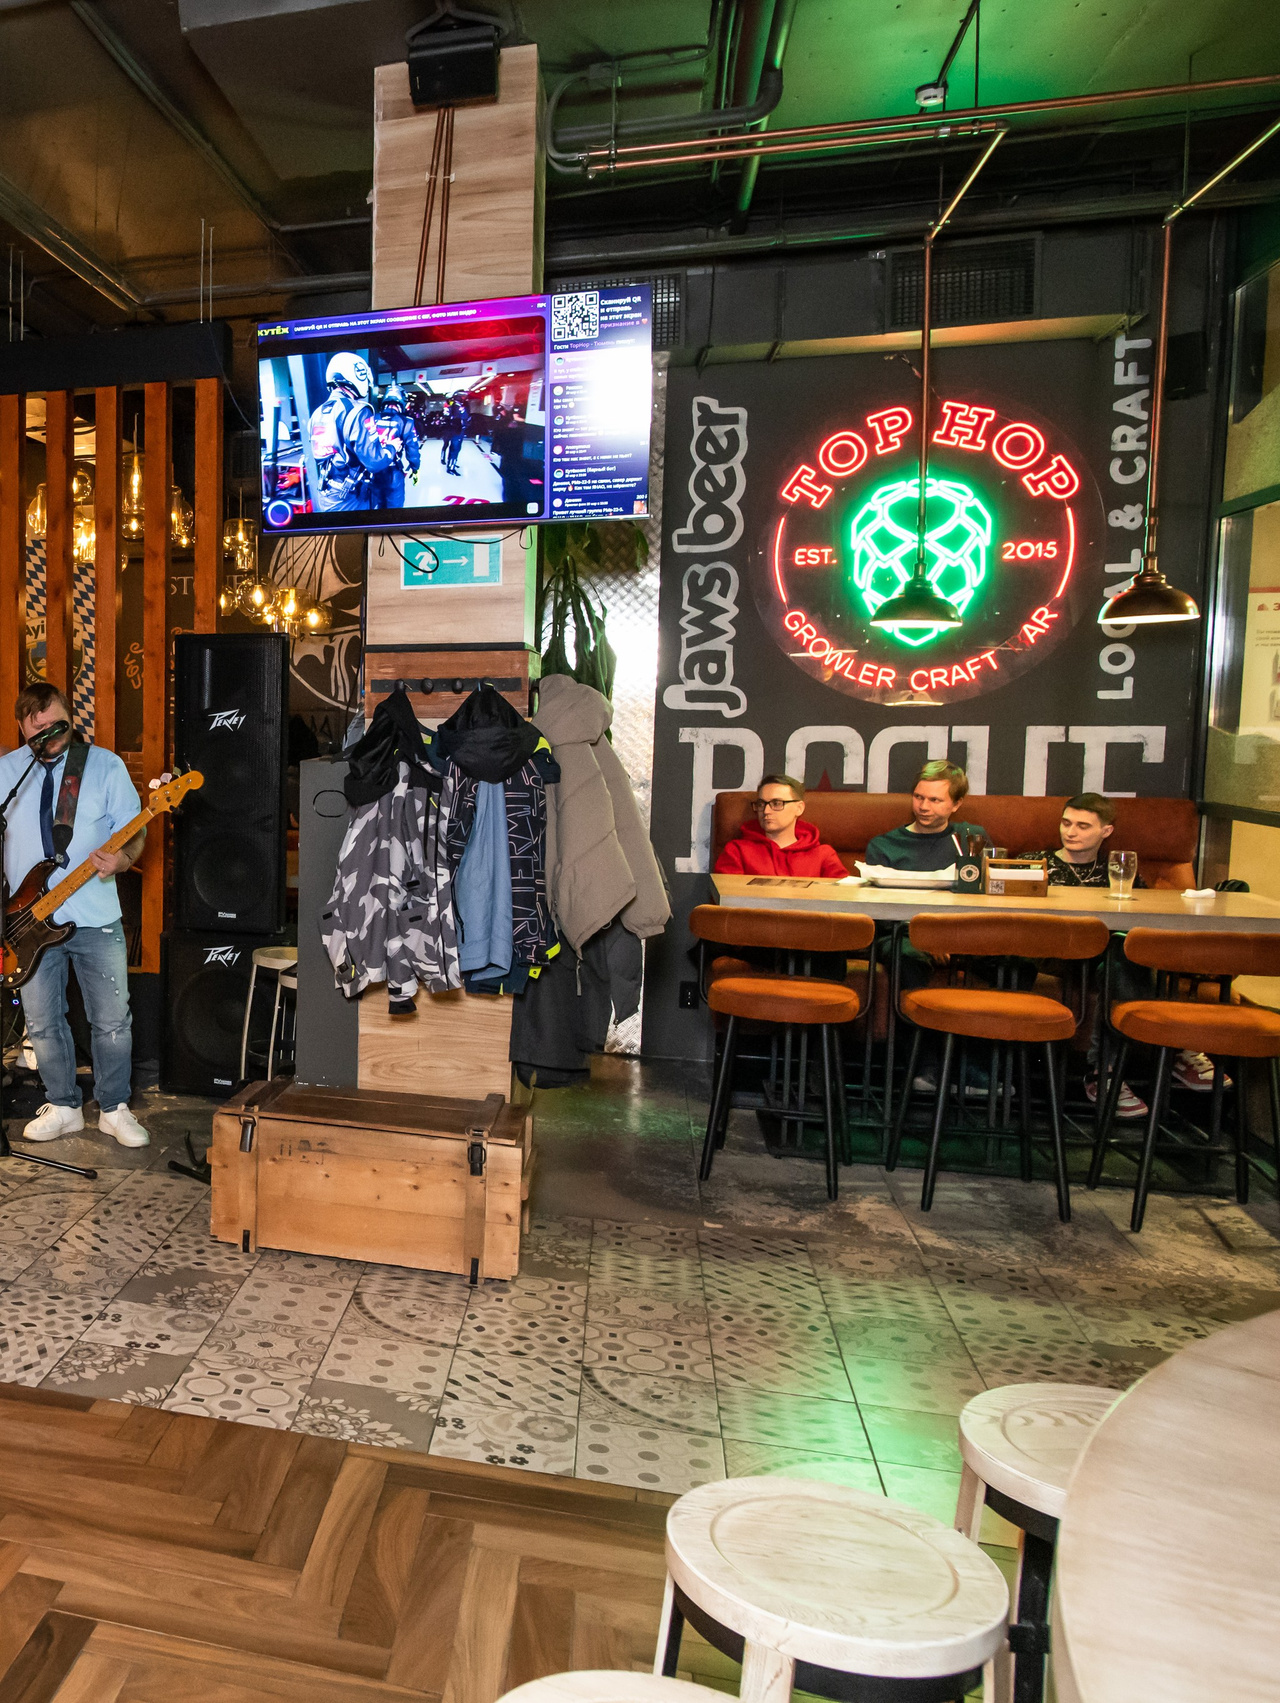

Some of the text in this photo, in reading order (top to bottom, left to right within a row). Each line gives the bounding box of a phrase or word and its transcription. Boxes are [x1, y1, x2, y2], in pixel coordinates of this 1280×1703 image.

[1109, 334, 1152, 485] CRAFT
[781, 401, 1080, 509] TOP HOP
[672, 396, 748, 554] beer
[1107, 506, 1144, 531] &
[794, 548, 838, 566] EST.
[1002, 541, 1058, 560] 2015
[784, 610, 897, 689] GROWLER
[909, 650, 998, 692] CRAFT
[208, 708, 247, 732] PEAVEY
[203, 945, 242, 968] PEAVEY
